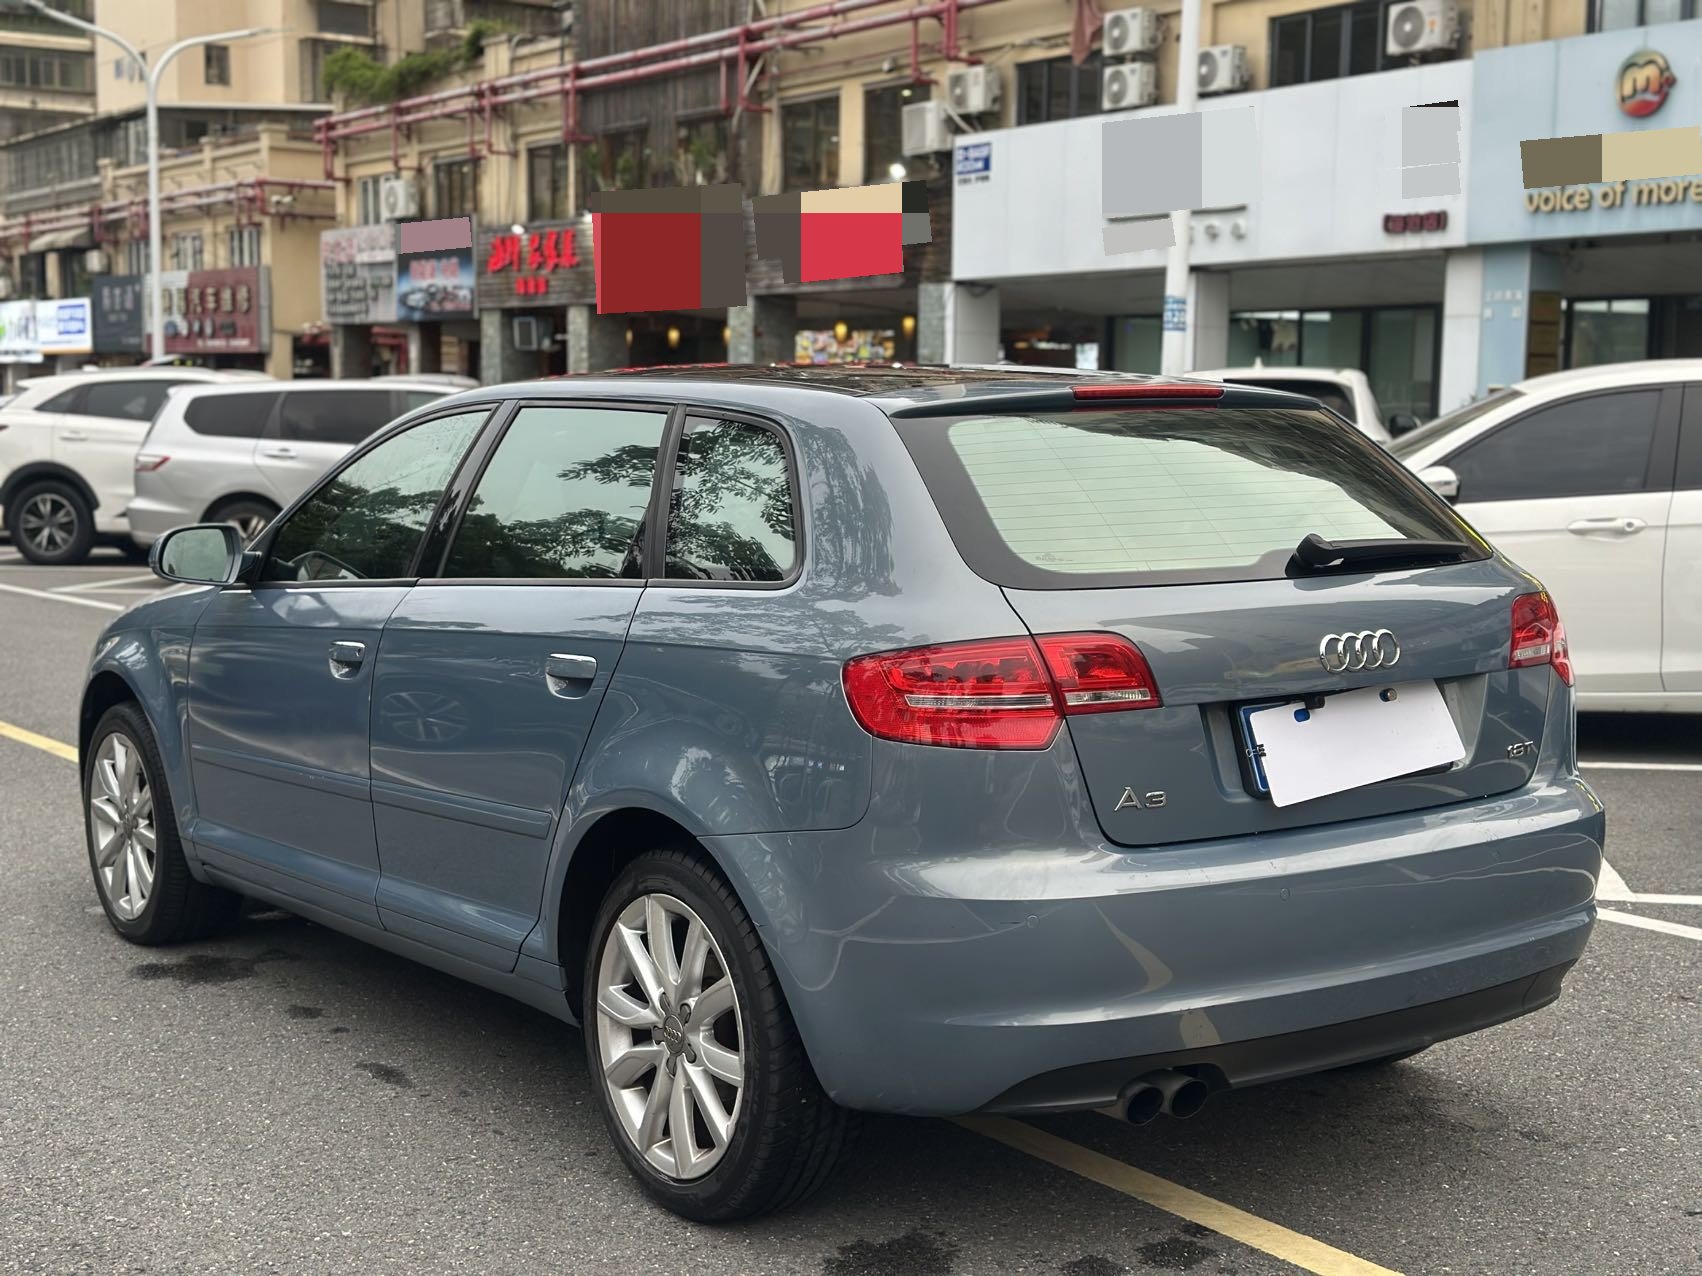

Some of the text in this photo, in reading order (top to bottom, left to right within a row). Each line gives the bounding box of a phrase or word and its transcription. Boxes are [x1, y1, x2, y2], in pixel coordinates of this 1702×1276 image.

[1525, 186, 1591, 213] voice
[1598, 180, 1627, 209] of
[1114, 786, 1167, 811] A3
